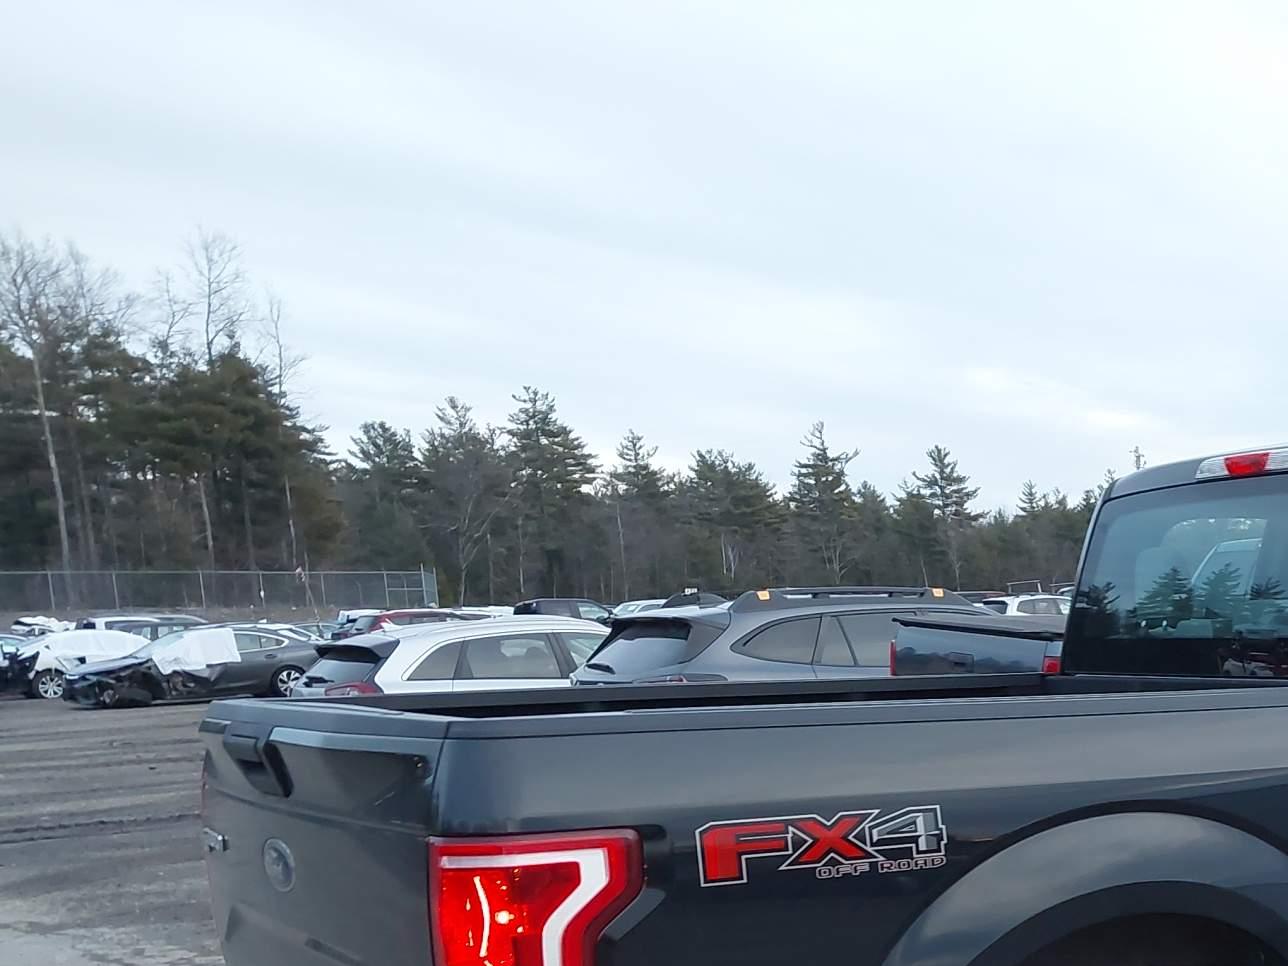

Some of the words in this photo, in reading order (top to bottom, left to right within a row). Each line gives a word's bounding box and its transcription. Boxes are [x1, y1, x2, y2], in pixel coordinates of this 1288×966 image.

[695, 804, 948, 888] FX4
[815, 863, 870, 880] OFF
[878, 855, 947, 873] ROAD
